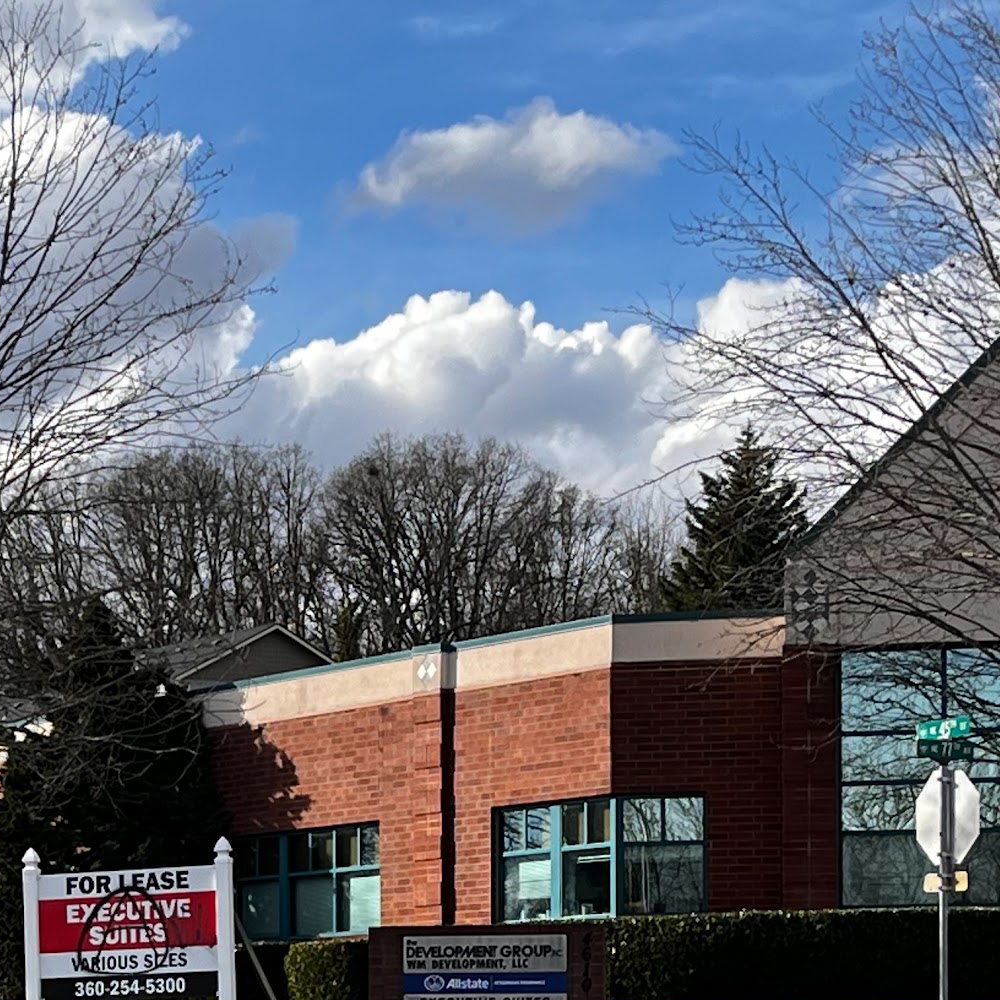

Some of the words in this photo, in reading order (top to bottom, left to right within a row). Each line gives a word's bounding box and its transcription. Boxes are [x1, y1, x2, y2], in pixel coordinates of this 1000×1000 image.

[66, 876, 111, 895] FOR
[119, 870, 190, 891] LEASE
[66, 898, 191, 924] EXECUTIVE
[89, 922, 167, 945] SUITES
[406, 945, 499, 959] DEVELOPMENT
[500, 944, 551, 958] GROUP
[71, 955, 139, 972] VARIOUS
[143, 953, 188, 969] SIZES
[406, 959, 427, 970] WM
[432, 959, 507, 970] DEVELOPMENT,
[511, 958, 529, 968] LLC
[74, 977, 187, 997] 360-254-5300
[446, 977, 490, 989] Allstate
